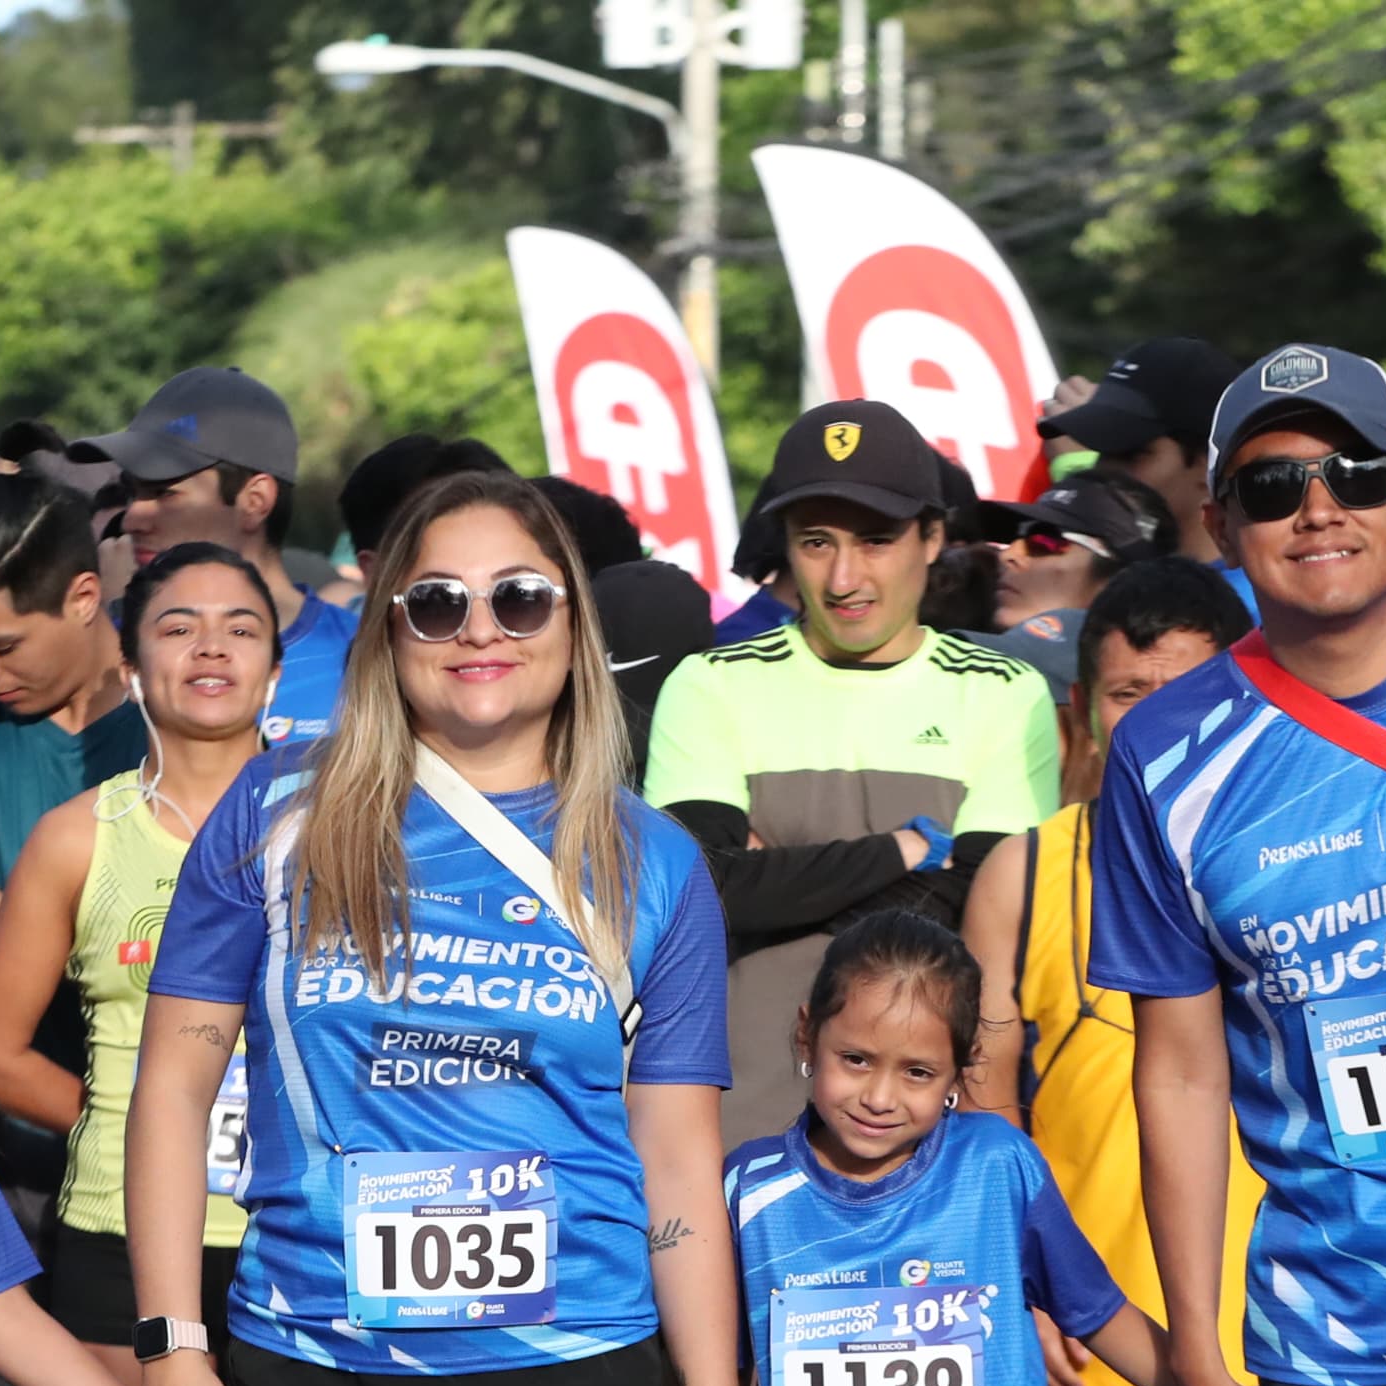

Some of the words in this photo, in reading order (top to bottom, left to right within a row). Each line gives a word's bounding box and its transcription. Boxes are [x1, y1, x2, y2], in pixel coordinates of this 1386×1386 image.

[1258, 840, 1319, 871] PRENSA
[1320, 829, 1363, 855] LIBRE
[420, 889, 462, 906] LIBRE
[1239, 914, 1259, 933] EN
[303, 957, 339, 970] POR
[1280, 951, 1303, 968] LA
[294, 968, 597, 1024] EDUCACIÓN
[381, 1029, 520, 1061] PRIMERA
[207, 1111, 245, 1163] 5
[358, 1169, 438, 1189] MOVIMIENTO
[466, 1155, 545, 1201] 10K
[357, 1181, 449, 1206] EDUCACIÓN
[420, 1207, 452, 1215] PRIMERA
[452, 1206, 483, 1215] EDICIÓN
[375, 1222, 535, 1291] 1035
[933, 1260, 965, 1270] GUATE
[784, 1271, 831, 1288] PRENSA
[832, 1268, 868, 1284] LIBRE
[933, 1269, 965, 1278] VISION
[786, 1305, 864, 1326] MOVIMIENTO
[892, 1290, 970, 1337] 10K
[783, 1318, 873, 1344] EDUCACIÓN
